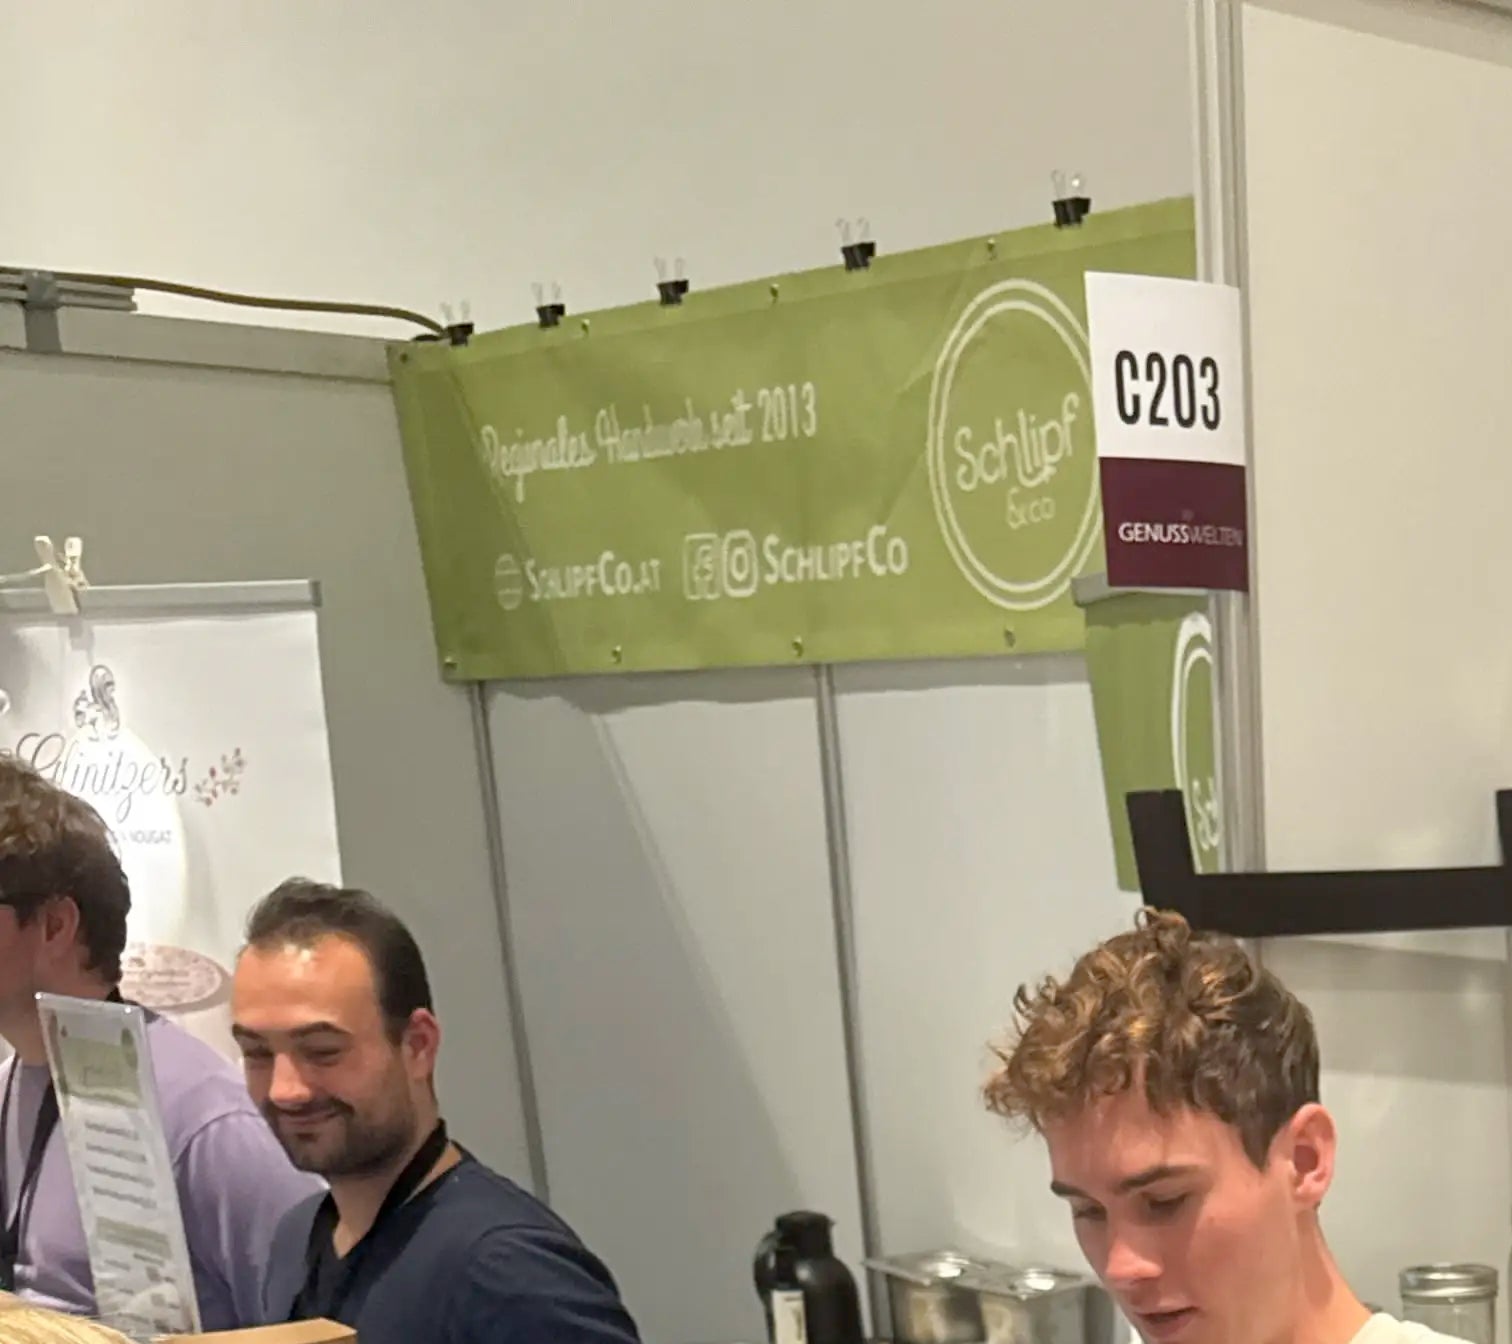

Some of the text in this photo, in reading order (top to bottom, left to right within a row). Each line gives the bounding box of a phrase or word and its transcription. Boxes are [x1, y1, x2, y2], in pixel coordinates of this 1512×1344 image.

[757, 381, 817, 442] 2013
[1115, 350, 1220, 430] C203
[954, 392, 1080, 491] Schlipf
[1118, 522, 1244, 547] GENUSSWELTEN
